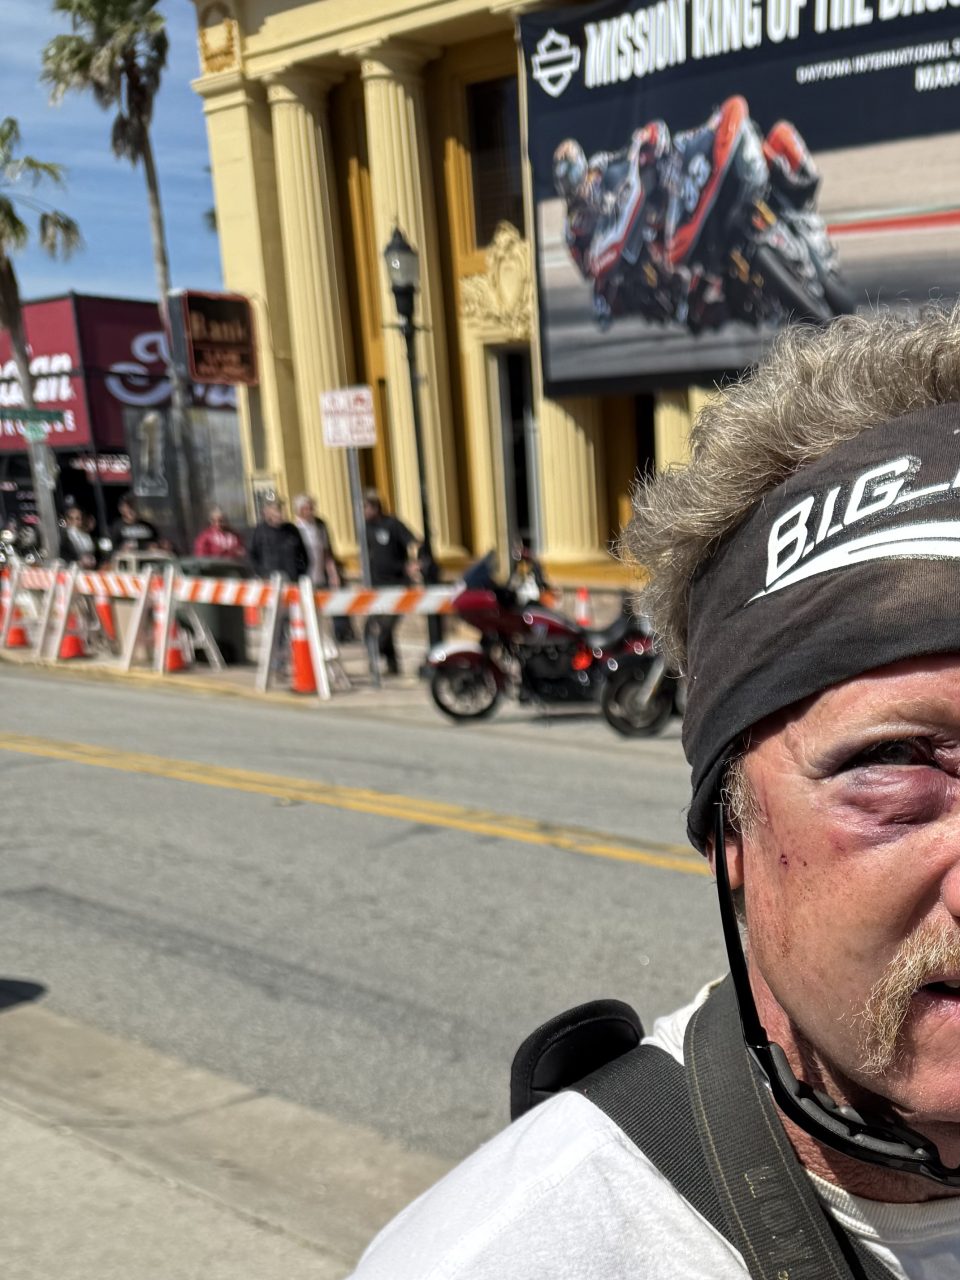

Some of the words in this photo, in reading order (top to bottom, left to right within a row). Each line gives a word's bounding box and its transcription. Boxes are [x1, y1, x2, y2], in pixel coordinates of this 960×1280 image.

[584, 0, 687, 89] MISSION
[691, 0, 763, 60] KING
[796, 56, 850, 84] DAYTONA
[851, 40, 951, 74] INTERNATIONAL
[765, 456, 911, 587] BIG
